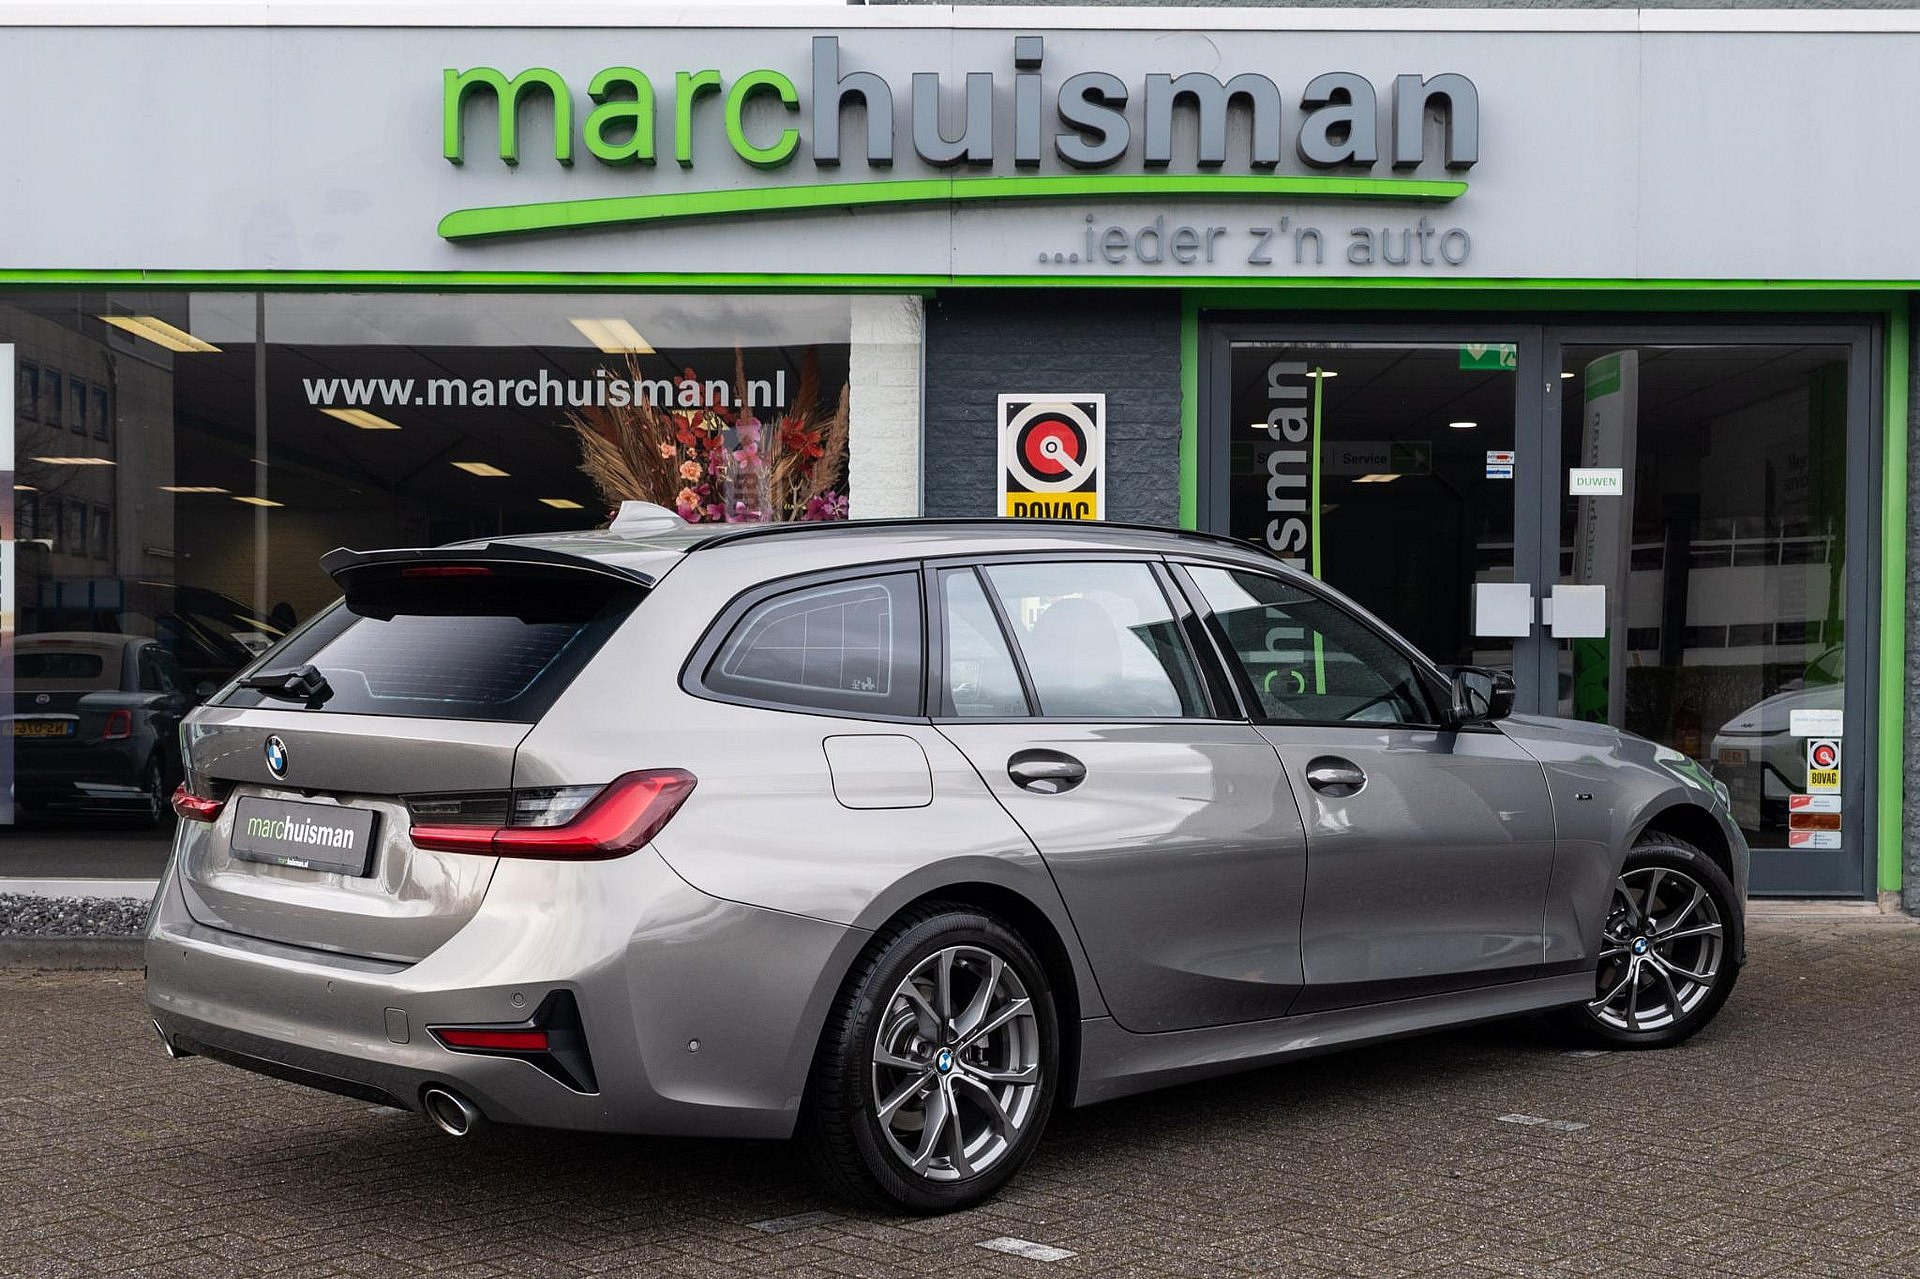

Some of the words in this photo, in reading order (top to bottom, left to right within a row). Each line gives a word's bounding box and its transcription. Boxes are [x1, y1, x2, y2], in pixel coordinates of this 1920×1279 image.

[443, 36, 1480, 170] marchuisman
[1247, 216, 1324, 265] z'n
[1347, 216, 1471, 265] auto
[302, 369, 786, 408] www.marchuisman.nl
[1343, 453, 1388, 465] Service
[1576, 477, 1617, 486] DUWEN
[1811, 772, 1837, 785] BOVAG
[247, 815, 355, 849] marchuisman
